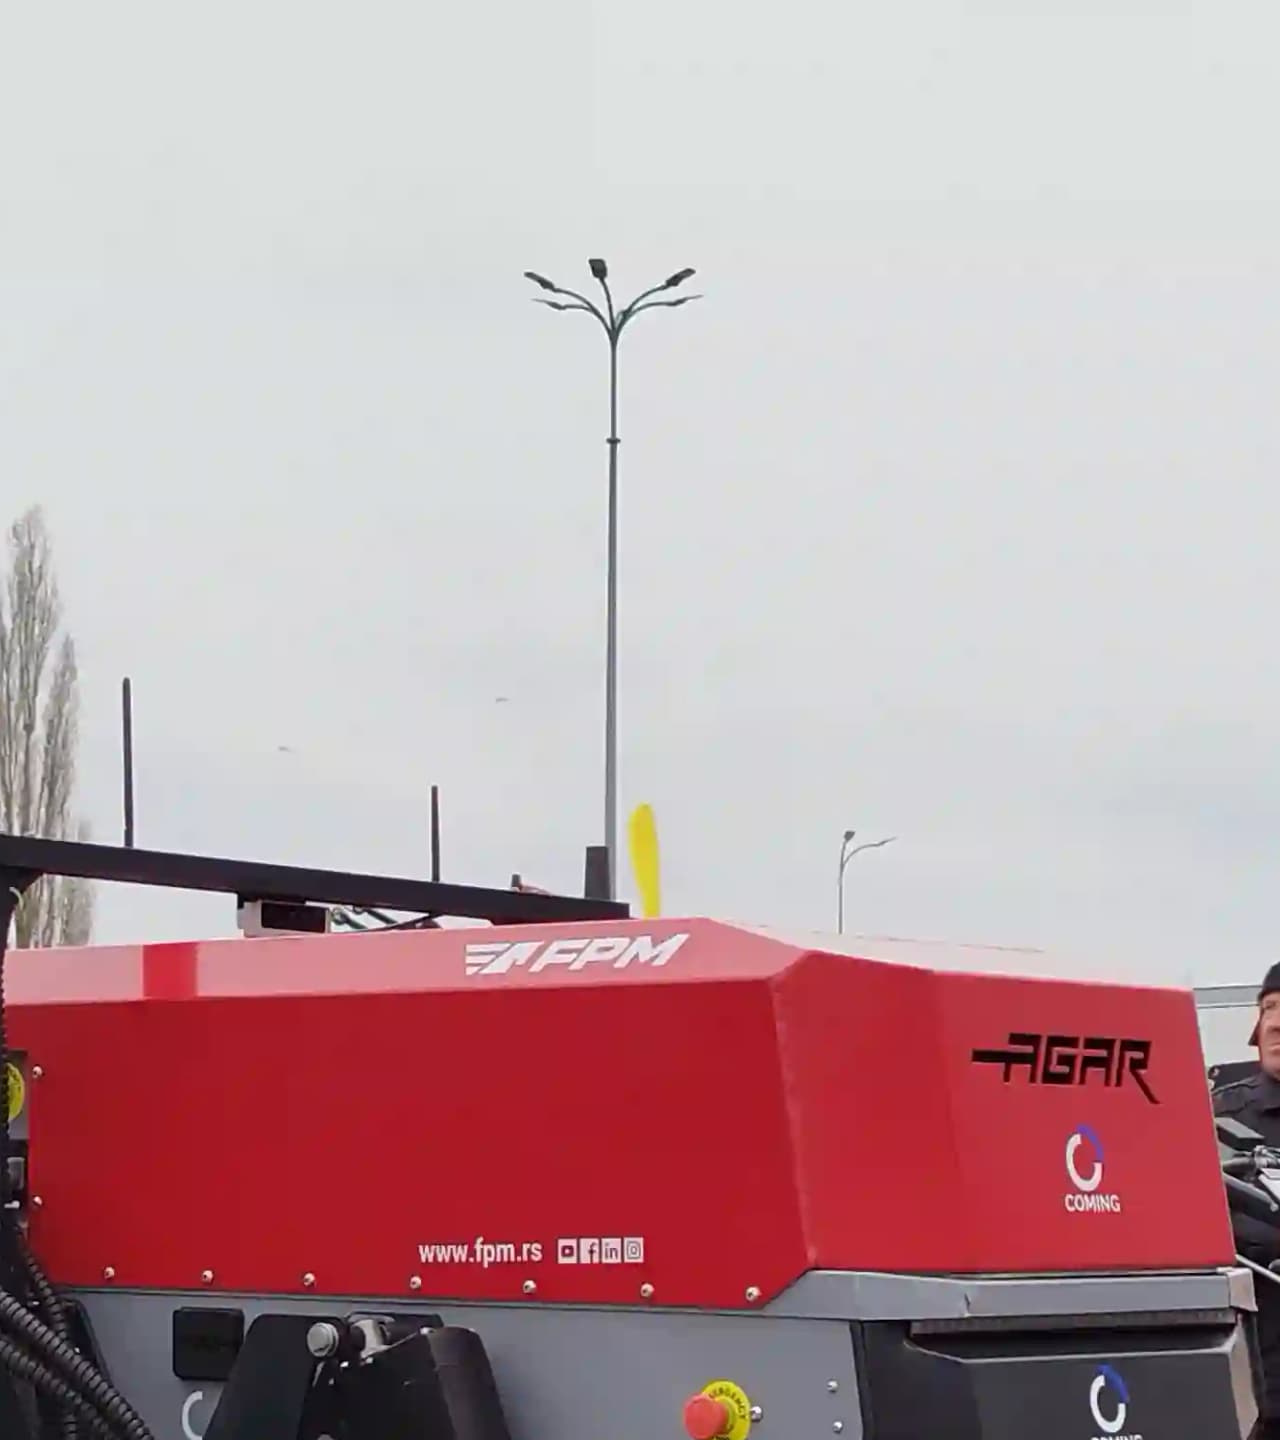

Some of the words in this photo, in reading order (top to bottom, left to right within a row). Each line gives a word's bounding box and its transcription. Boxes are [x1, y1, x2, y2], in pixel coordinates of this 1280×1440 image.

[528, 933, 690, 973] FPM
[972, 1032, 1161, 1105] AGAR
[1065, 1194, 1121, 1212] COMING
[419, 1236, 543, 1268] www.fpm.rs
